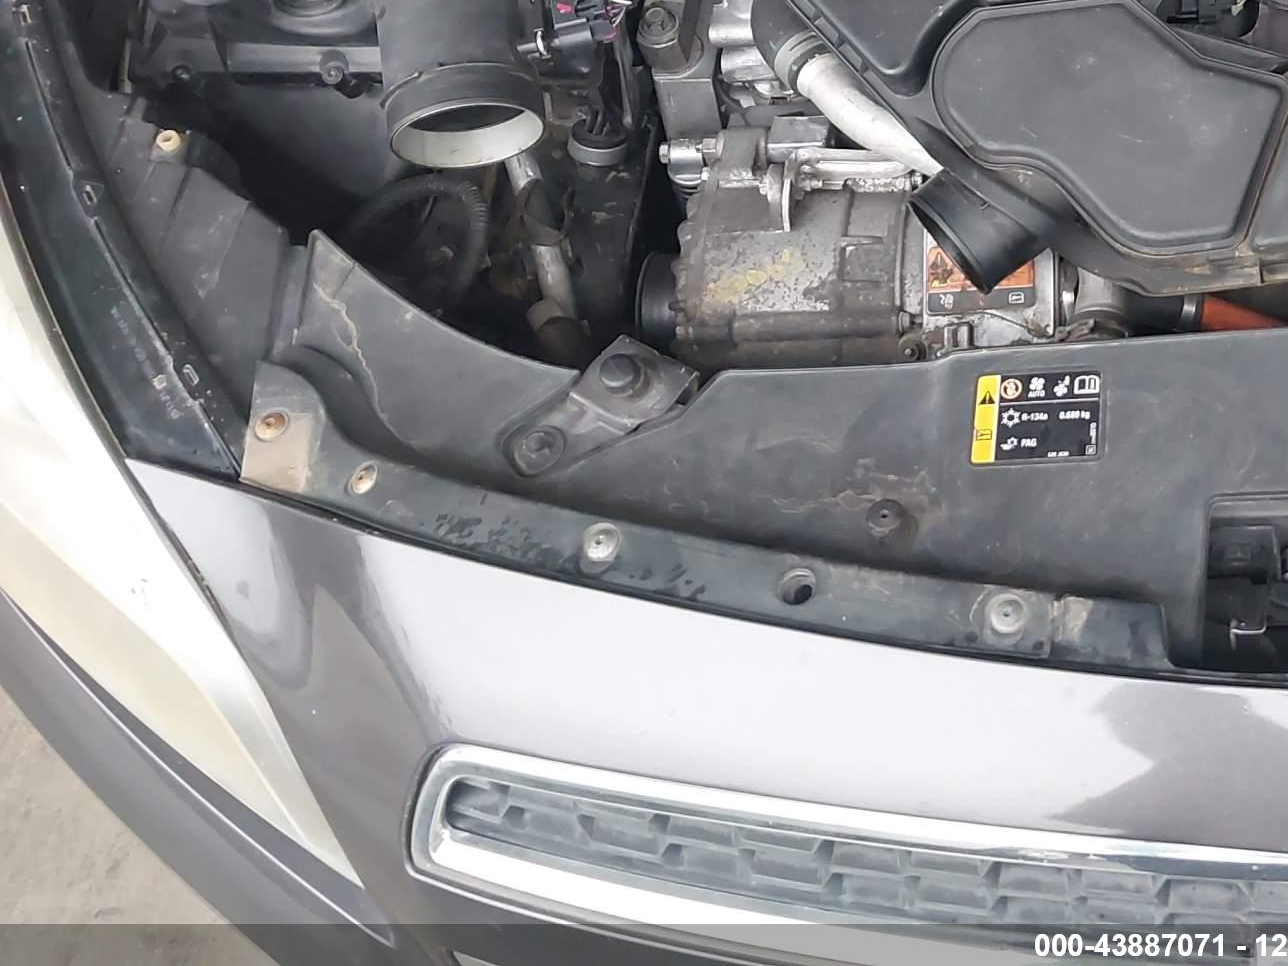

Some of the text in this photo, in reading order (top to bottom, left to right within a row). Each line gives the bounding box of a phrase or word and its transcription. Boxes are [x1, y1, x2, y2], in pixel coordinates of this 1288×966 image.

[1028, 390, 1046, 398] AUTO
[1021, 411, 1049, 421] R-134a
[1021, 438, 1037, 447] PAG
